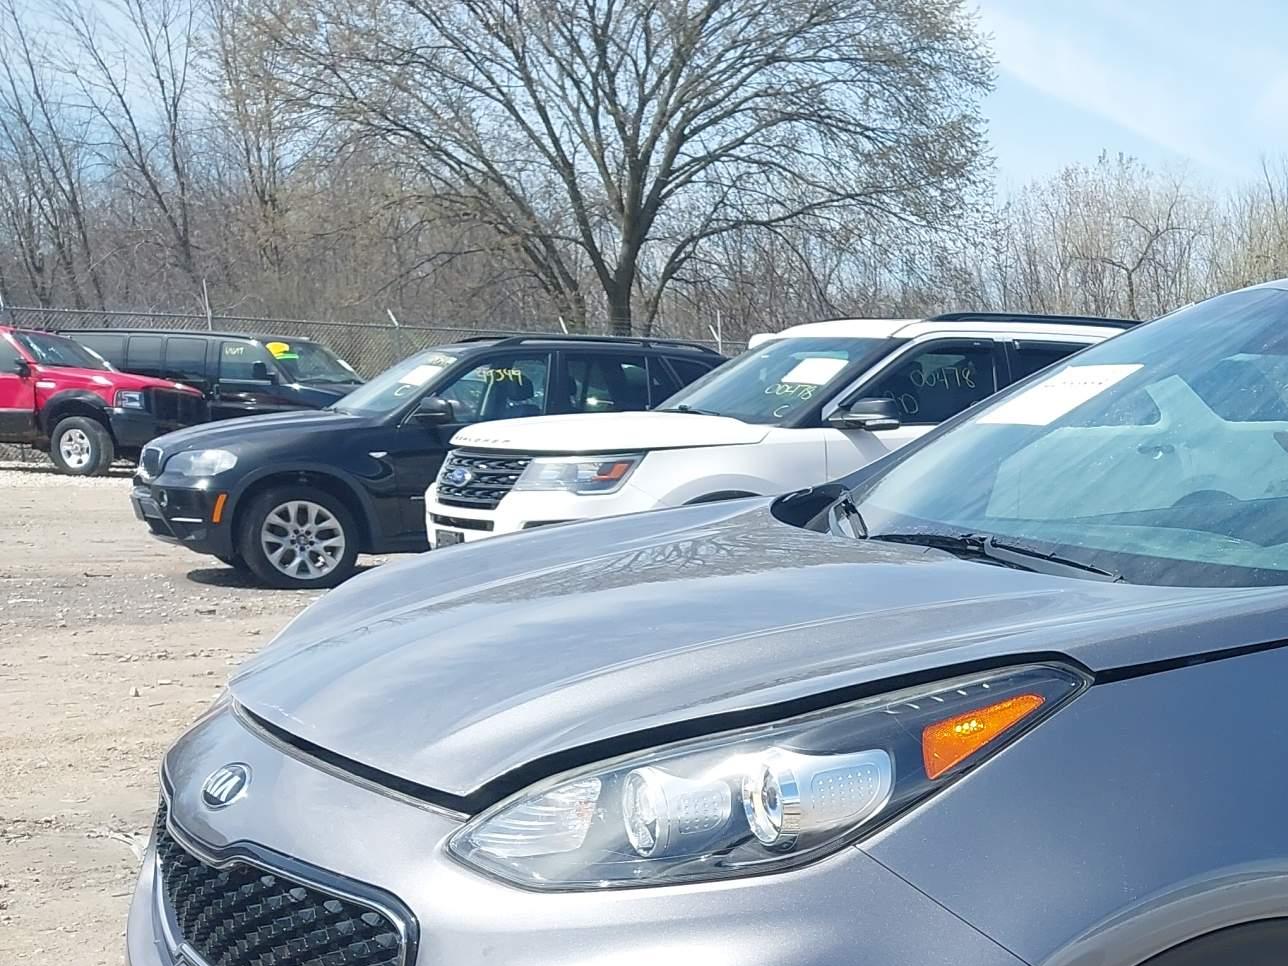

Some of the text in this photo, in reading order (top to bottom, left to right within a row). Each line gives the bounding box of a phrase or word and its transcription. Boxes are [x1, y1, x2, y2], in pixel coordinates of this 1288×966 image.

[909, 367, 976, 390] 00478
[765, 383, 817, 400] 00478
[773, 404, 790, 418] C
